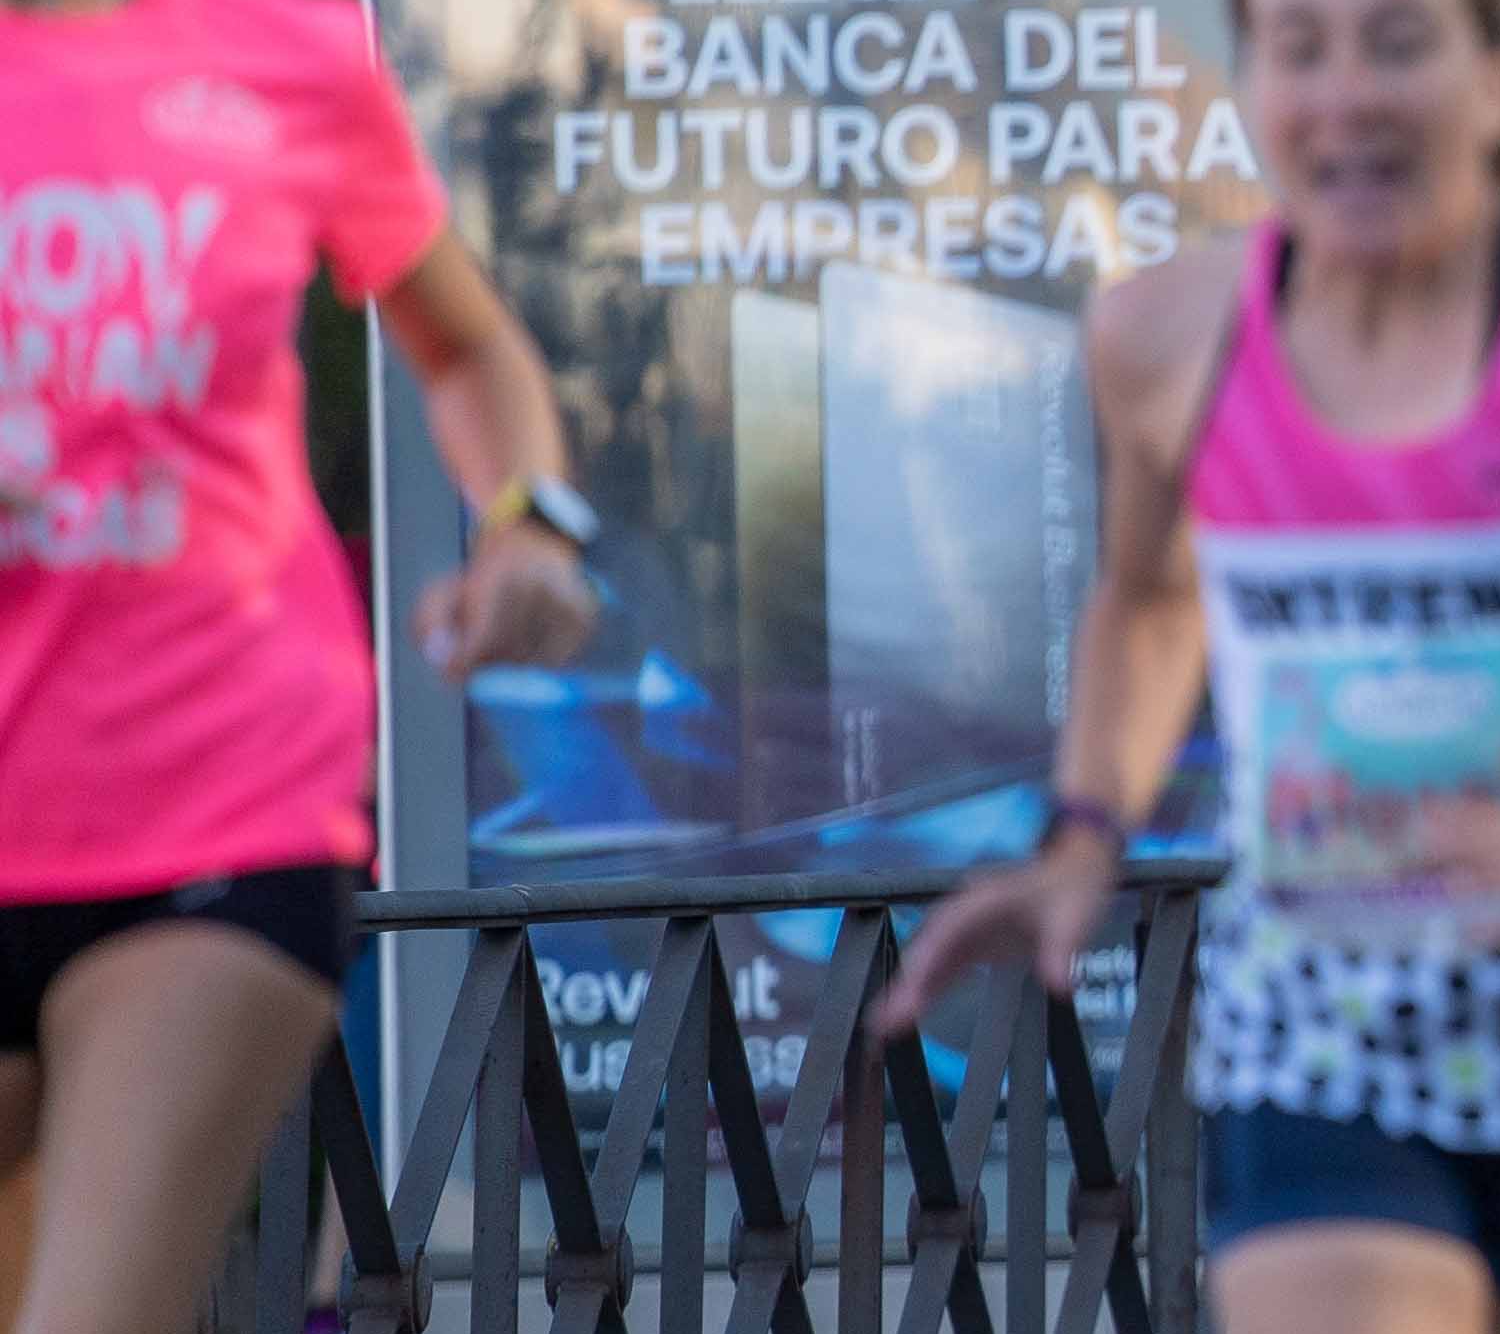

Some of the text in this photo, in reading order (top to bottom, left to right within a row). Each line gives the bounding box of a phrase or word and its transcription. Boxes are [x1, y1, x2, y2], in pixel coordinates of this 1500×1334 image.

[622, 6, 1188, 99] BANCA DEL
[554, 98, 1264, 193] FUTURO PARA
[641, 191, 1182, 288] EMPRESAS
